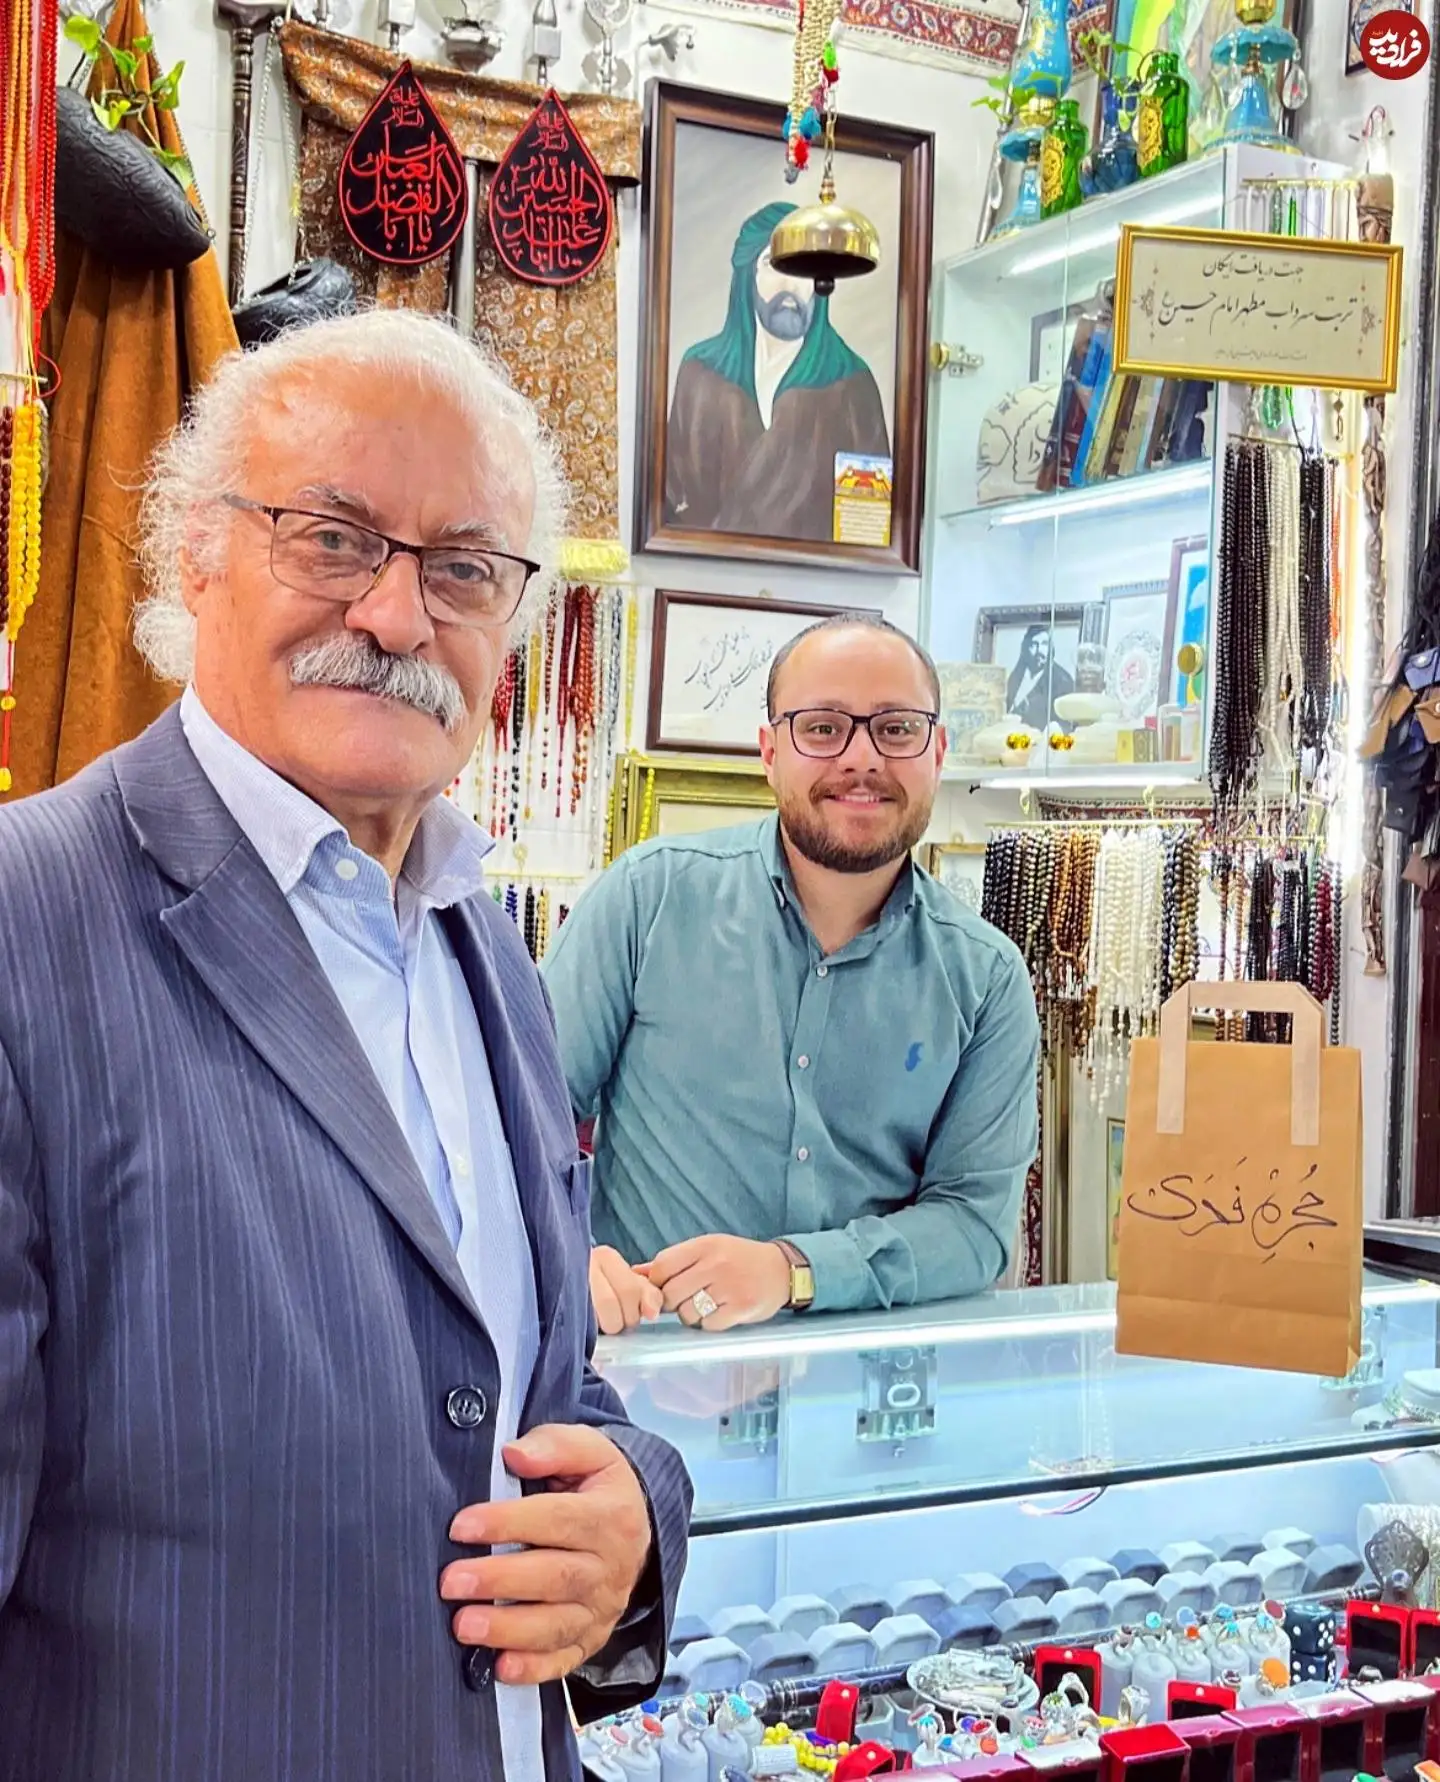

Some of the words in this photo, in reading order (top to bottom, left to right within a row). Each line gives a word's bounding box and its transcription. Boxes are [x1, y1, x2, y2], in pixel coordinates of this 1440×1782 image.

[1235, 254, 1274, 282] دریافت
[1158, 291, 1216, 327] حسین
[1209, 296, 1239, 336] امام
[1230, 289, 1265, 324] مطهر
[1265, 301, 1314, 330] سرداب
[1314, 296, 1357, 332] تربت
